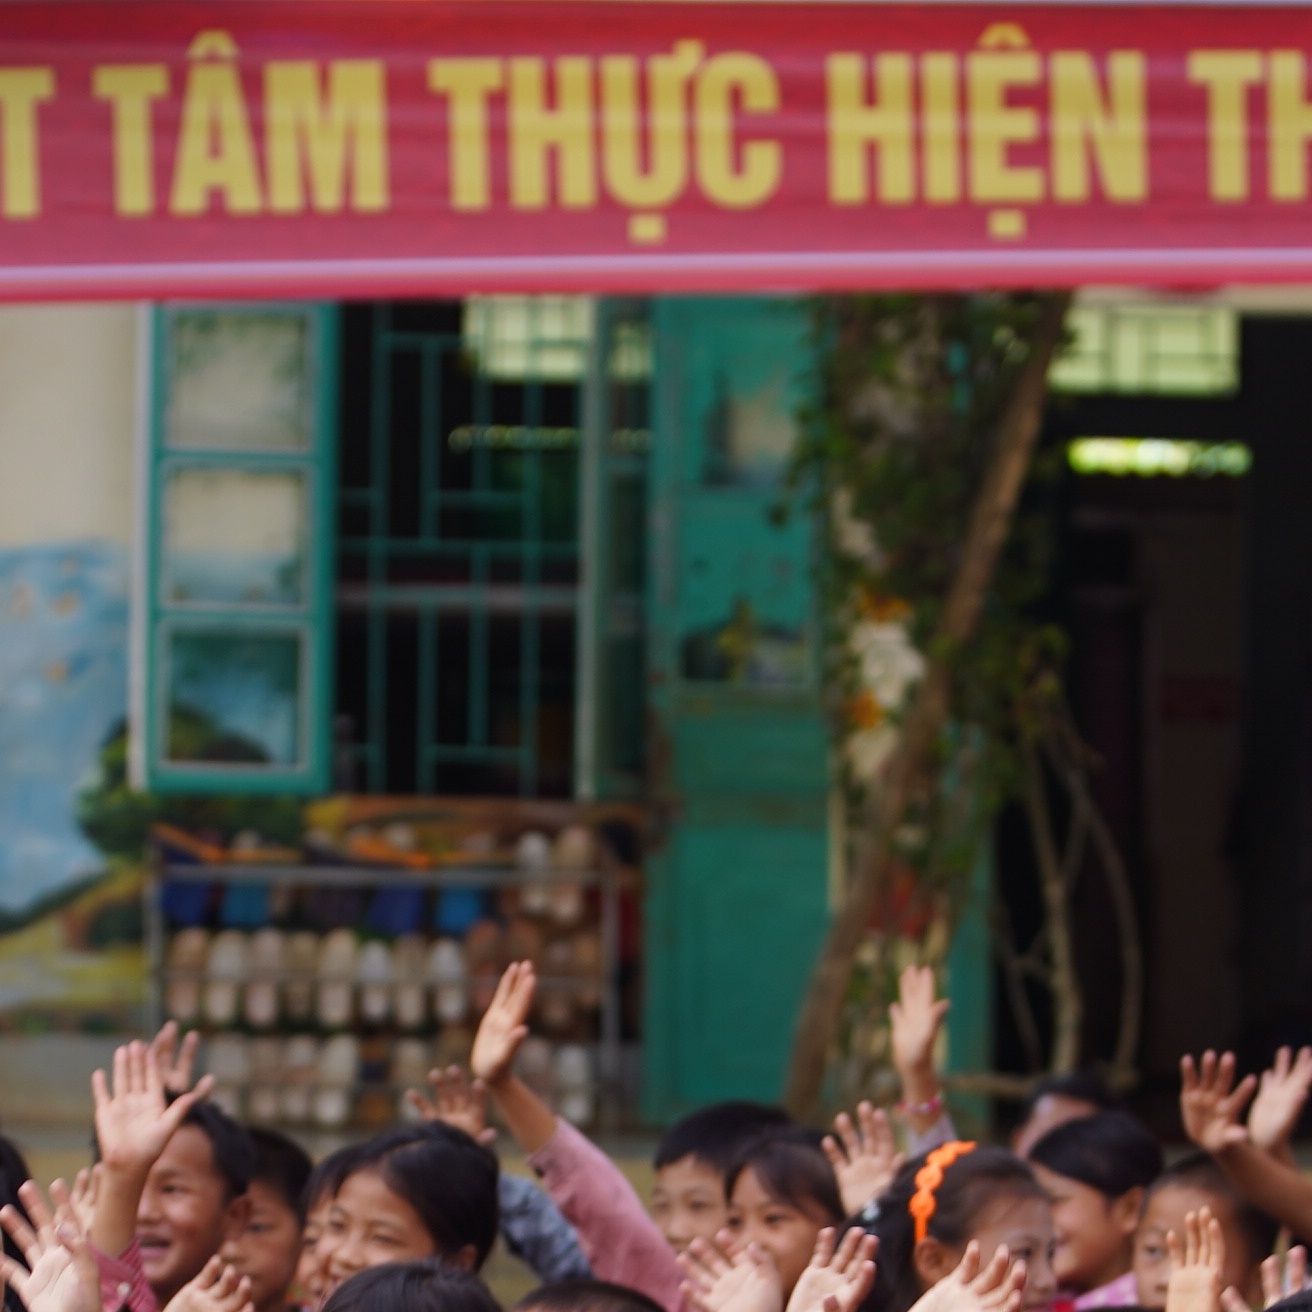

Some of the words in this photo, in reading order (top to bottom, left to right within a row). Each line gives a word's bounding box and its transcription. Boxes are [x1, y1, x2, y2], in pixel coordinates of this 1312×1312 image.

[95, 34, 386, 213] TÂM
[429, 41, 778, 239] THỰC
[828, 26, 1145, 234] HIỆN
